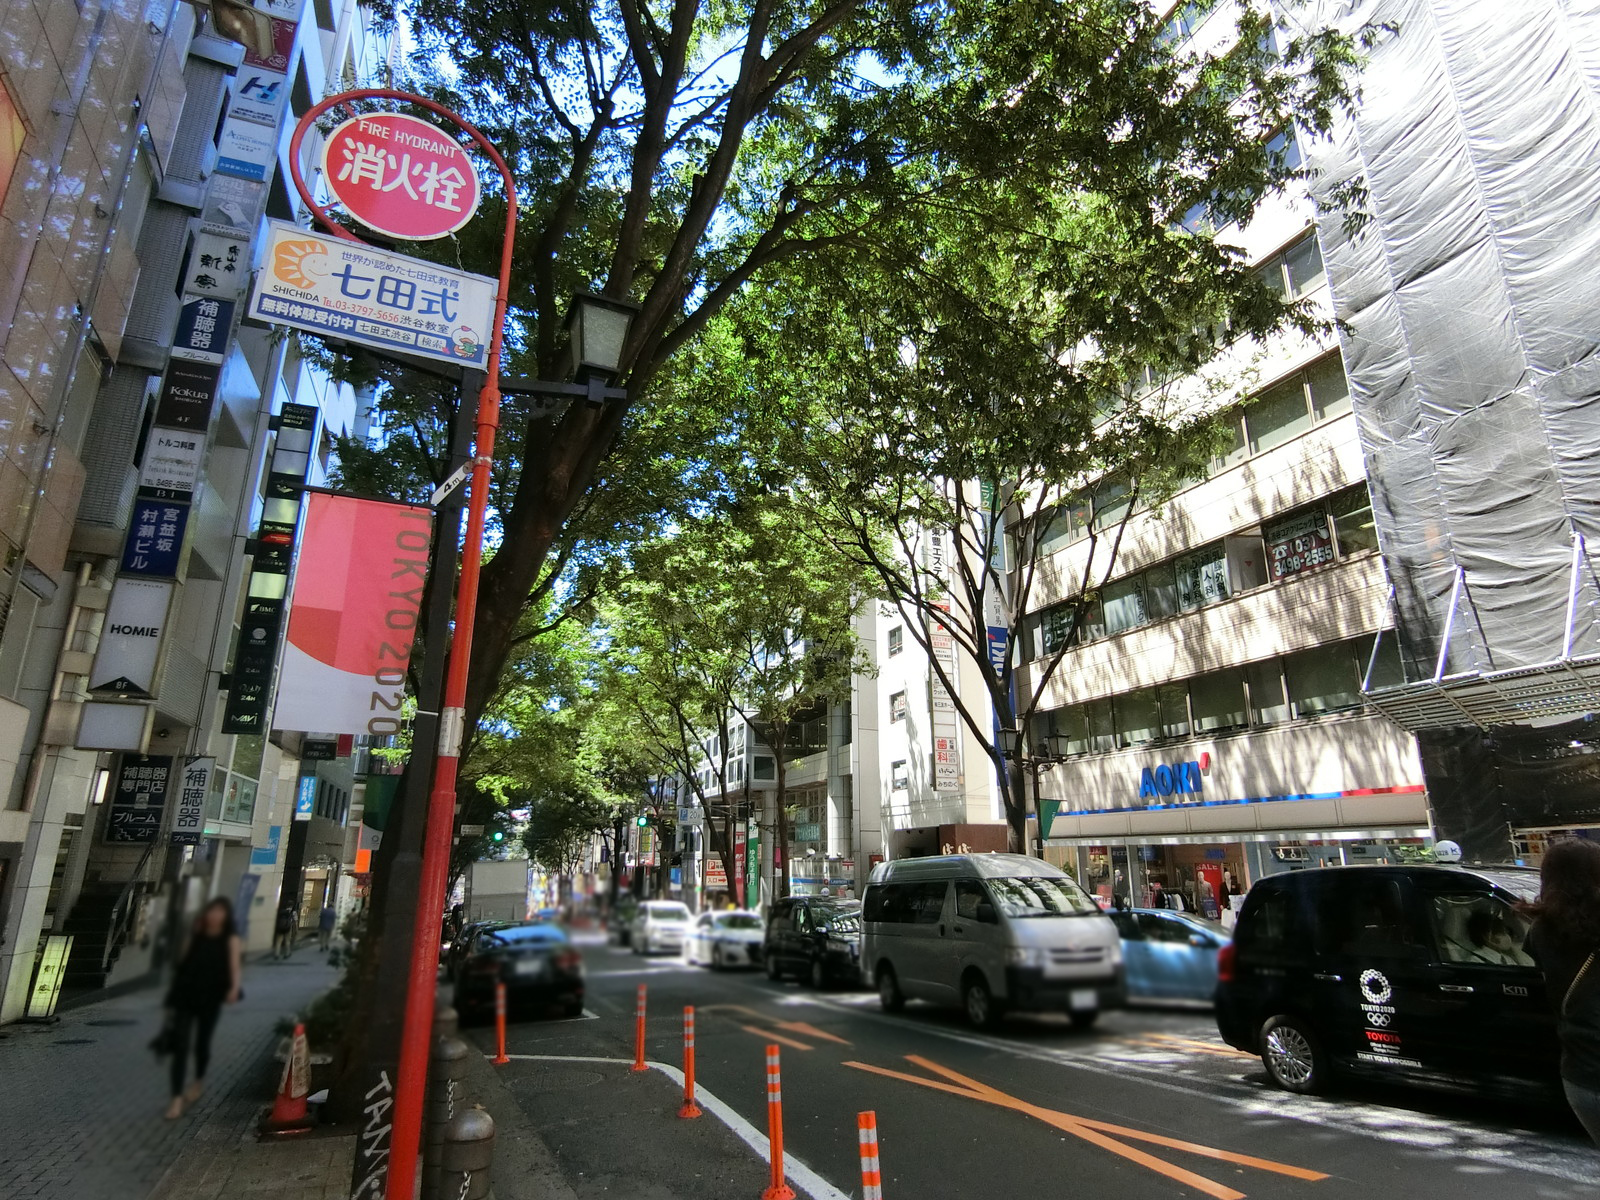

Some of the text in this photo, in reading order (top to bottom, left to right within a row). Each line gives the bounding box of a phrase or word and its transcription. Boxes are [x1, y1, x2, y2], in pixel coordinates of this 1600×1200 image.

[360, 120, 457, 158] FIRE HYDRANT
[338, 137, 466, 212] 消火栓
[341, 251, 460, 289] 世界が認めた七田式教育
[273, 284, 320, 303] SHICHIDA
[332, 263, 460, 323] 七田式
[261, 298, 355, 330] 無料体験受付中
[191, 300, 220, 349] 補聴器
[358, 322, 412, 342] 七田式渋谷
[400, 315, 450, 335] 渋谷教室
[421, 334, 445, 349] 検索
[183, 351, 211, 361] ブルーム
[170, 385, 209, 400] Kokua
[158, 437, 196, 451] トルコ料理
[131, 508, 159, 570] 村瀬ビル
[157, 508, 180, 552] 宮益坂
[1290, 534, 1316, 555] (03)
[1274, 545, 1334, 577] 3498-2555
[110, 624, 159, 638] HOMIE
[367, 511, 433, 736] TOKYO 2020
[115, 681, 128, 689] 8F
[123, 767, 168, 779] 補聴器
[1139, 760, 1203, 798] AOKI
[120, 780, 166, 793] 専門店
[937, 780, 958, 788] みちのく
[178, 767, 209, 827] 補聴器
[113, 812, 156, 823] ブルーム
[137, 827, 154, 837] 2F
[1196, 863, 1219, 872] SALE
[1361, 1003, 1395, 1013] TOKYO 2020
[1366, 1031, 1402, 1043] TOYOTA
[1374, 1055, 1389, 1063] YOUR
